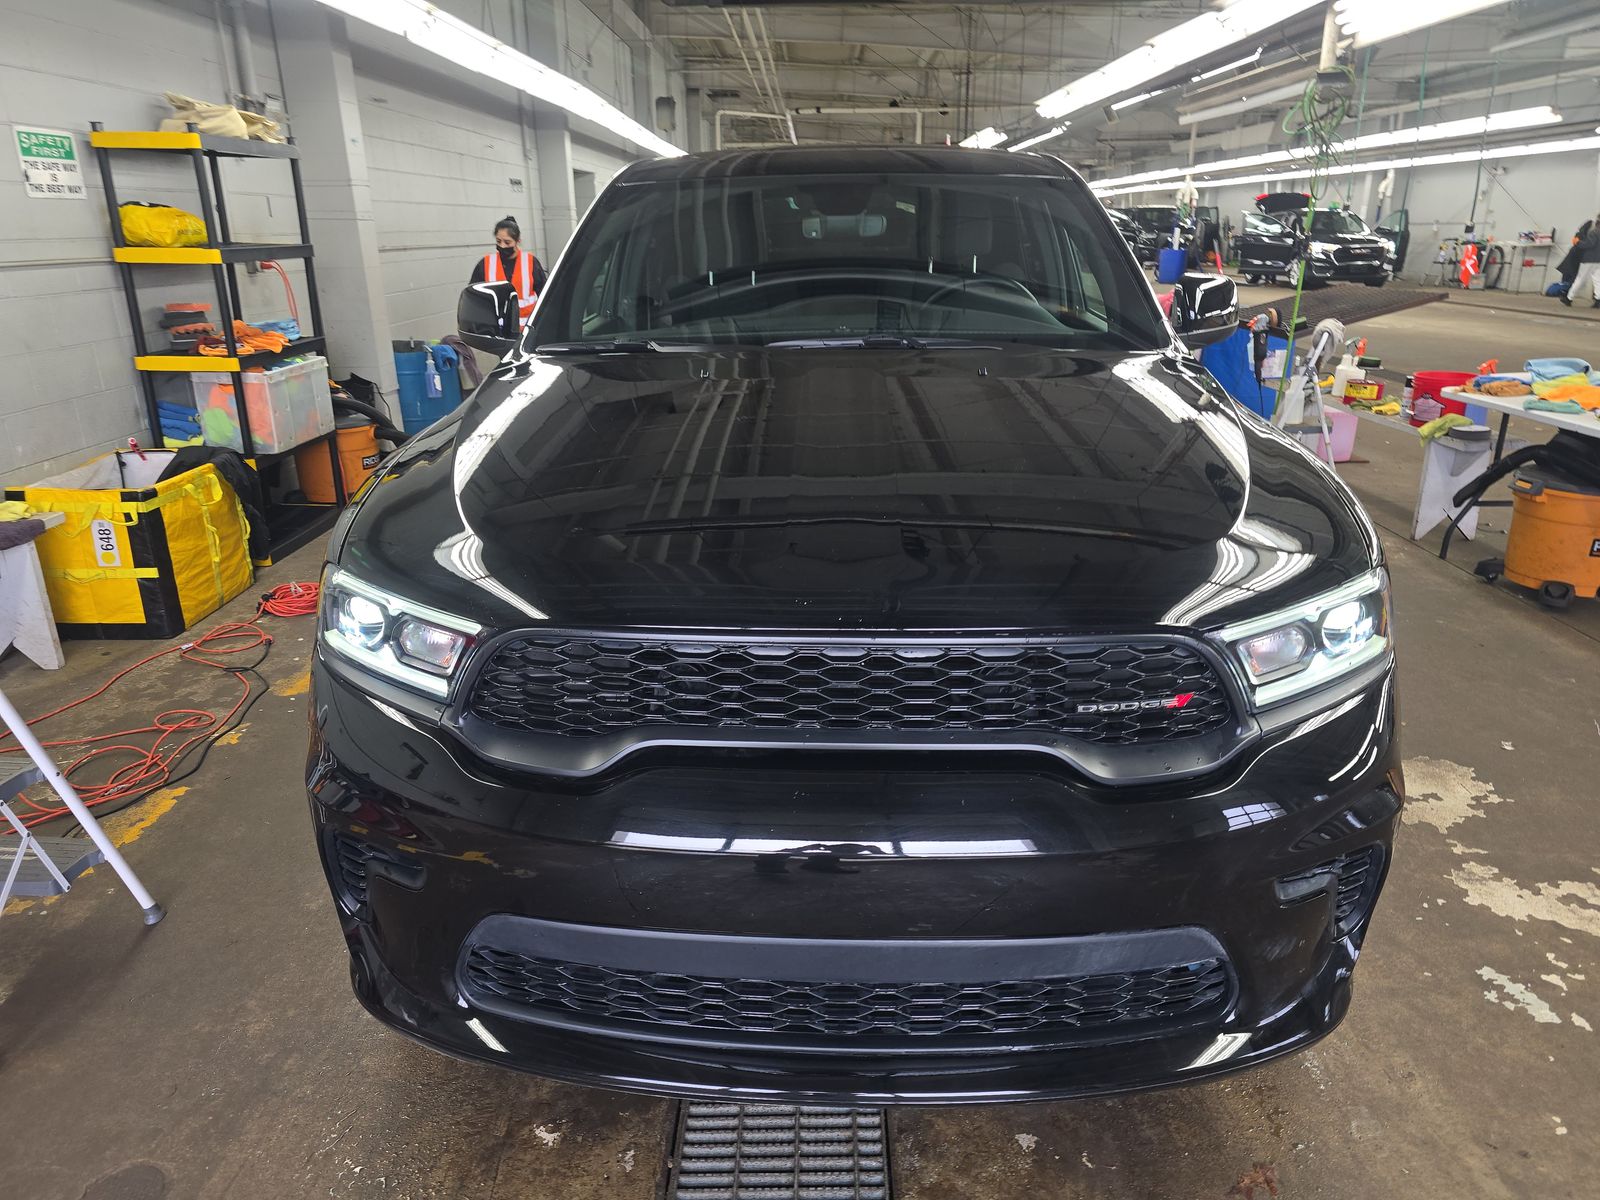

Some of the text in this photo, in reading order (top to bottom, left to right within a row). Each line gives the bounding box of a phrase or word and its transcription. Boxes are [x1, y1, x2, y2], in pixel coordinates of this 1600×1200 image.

[20, 133, 70, 151] SAFETY
[31, 146, 66, 157] FIRST
[23, 160, 78, 173] THE SAFE WAY
[28, 183, 83, 194] THE BEST WAY
[98, 528, 114, 551] 648
[1077, 699, 1178, 713] DODGE
